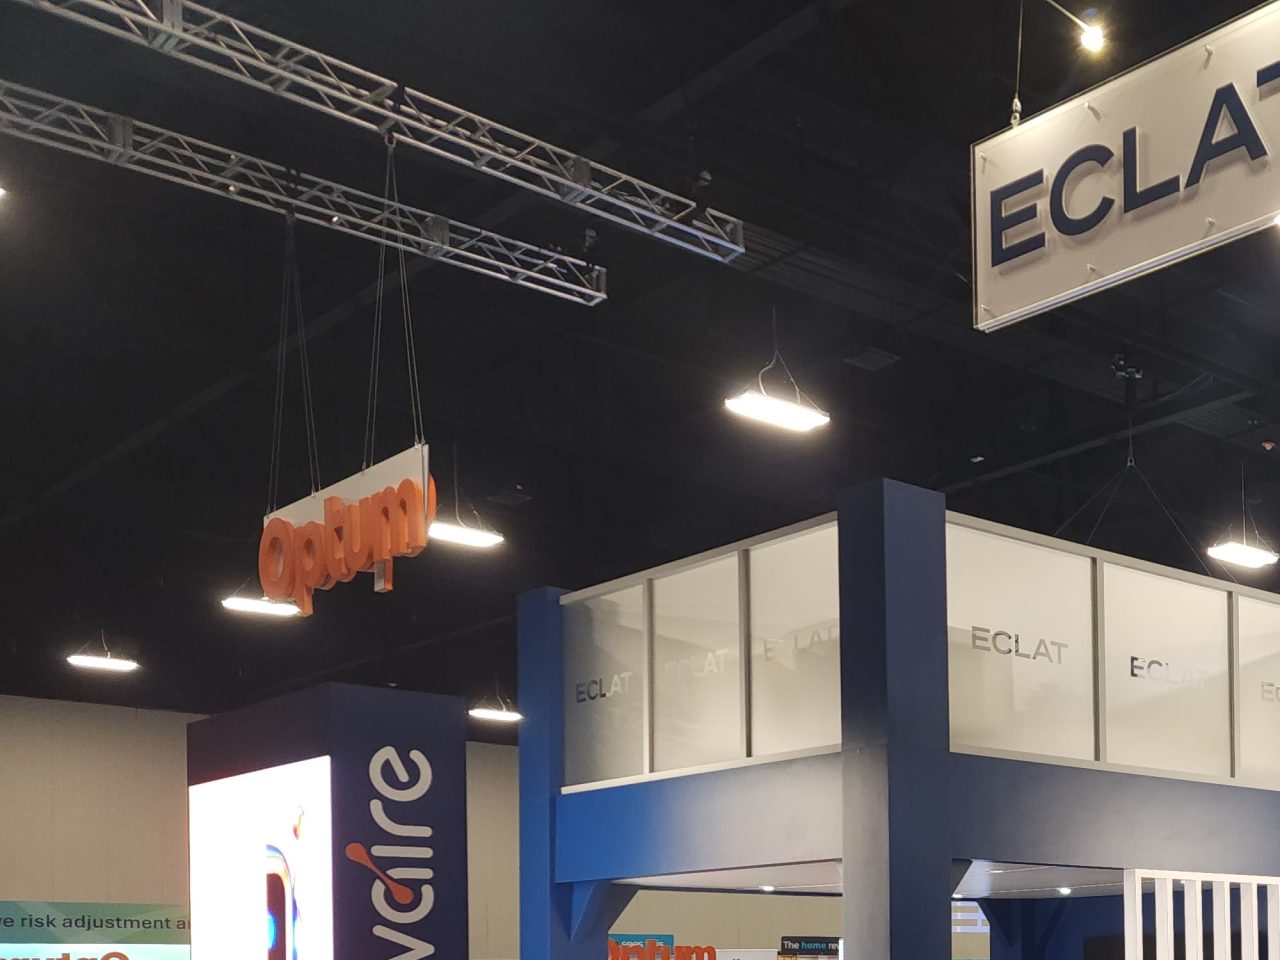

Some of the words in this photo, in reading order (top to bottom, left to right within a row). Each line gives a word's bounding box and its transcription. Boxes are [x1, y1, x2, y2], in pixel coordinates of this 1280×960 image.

[258, 478, 428, 616] Optum
[970, 624, 1070, 665] ECLAT
[575, 671, 633, 704] ECLAT
[20, 914, 57, 928] risk
[62, 915, 171, 931] adjustment
[783, 940, 800, 950] The
[801, 940, 827, 949] home
